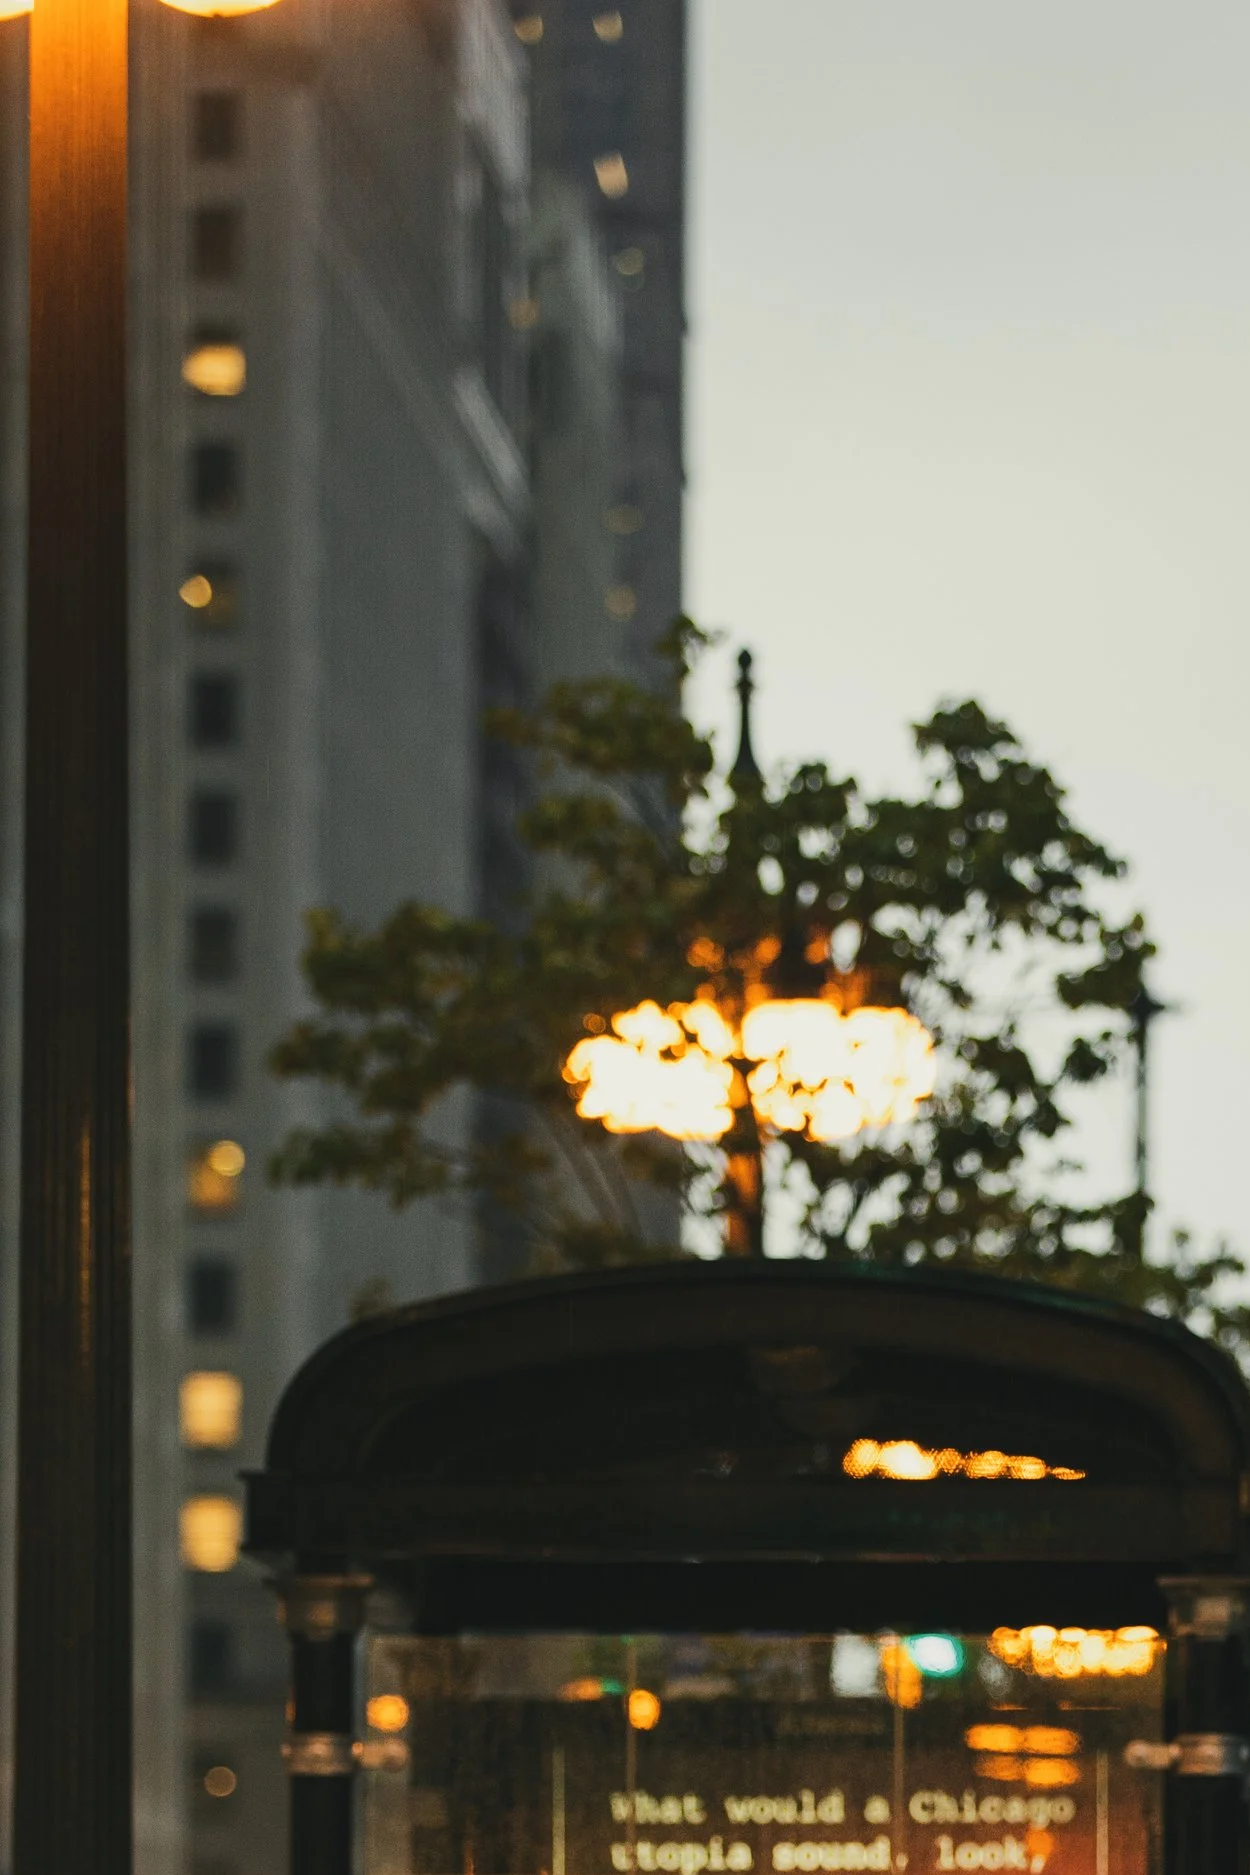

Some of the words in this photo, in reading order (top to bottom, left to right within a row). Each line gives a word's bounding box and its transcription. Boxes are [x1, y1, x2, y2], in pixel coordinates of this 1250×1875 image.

[610, 1790, 706, 1824] What
[724, 1788, 845, 1824] would
[864, 1795, 890, 1824] a
[909, 1789, 1077, 1829] Chicago
